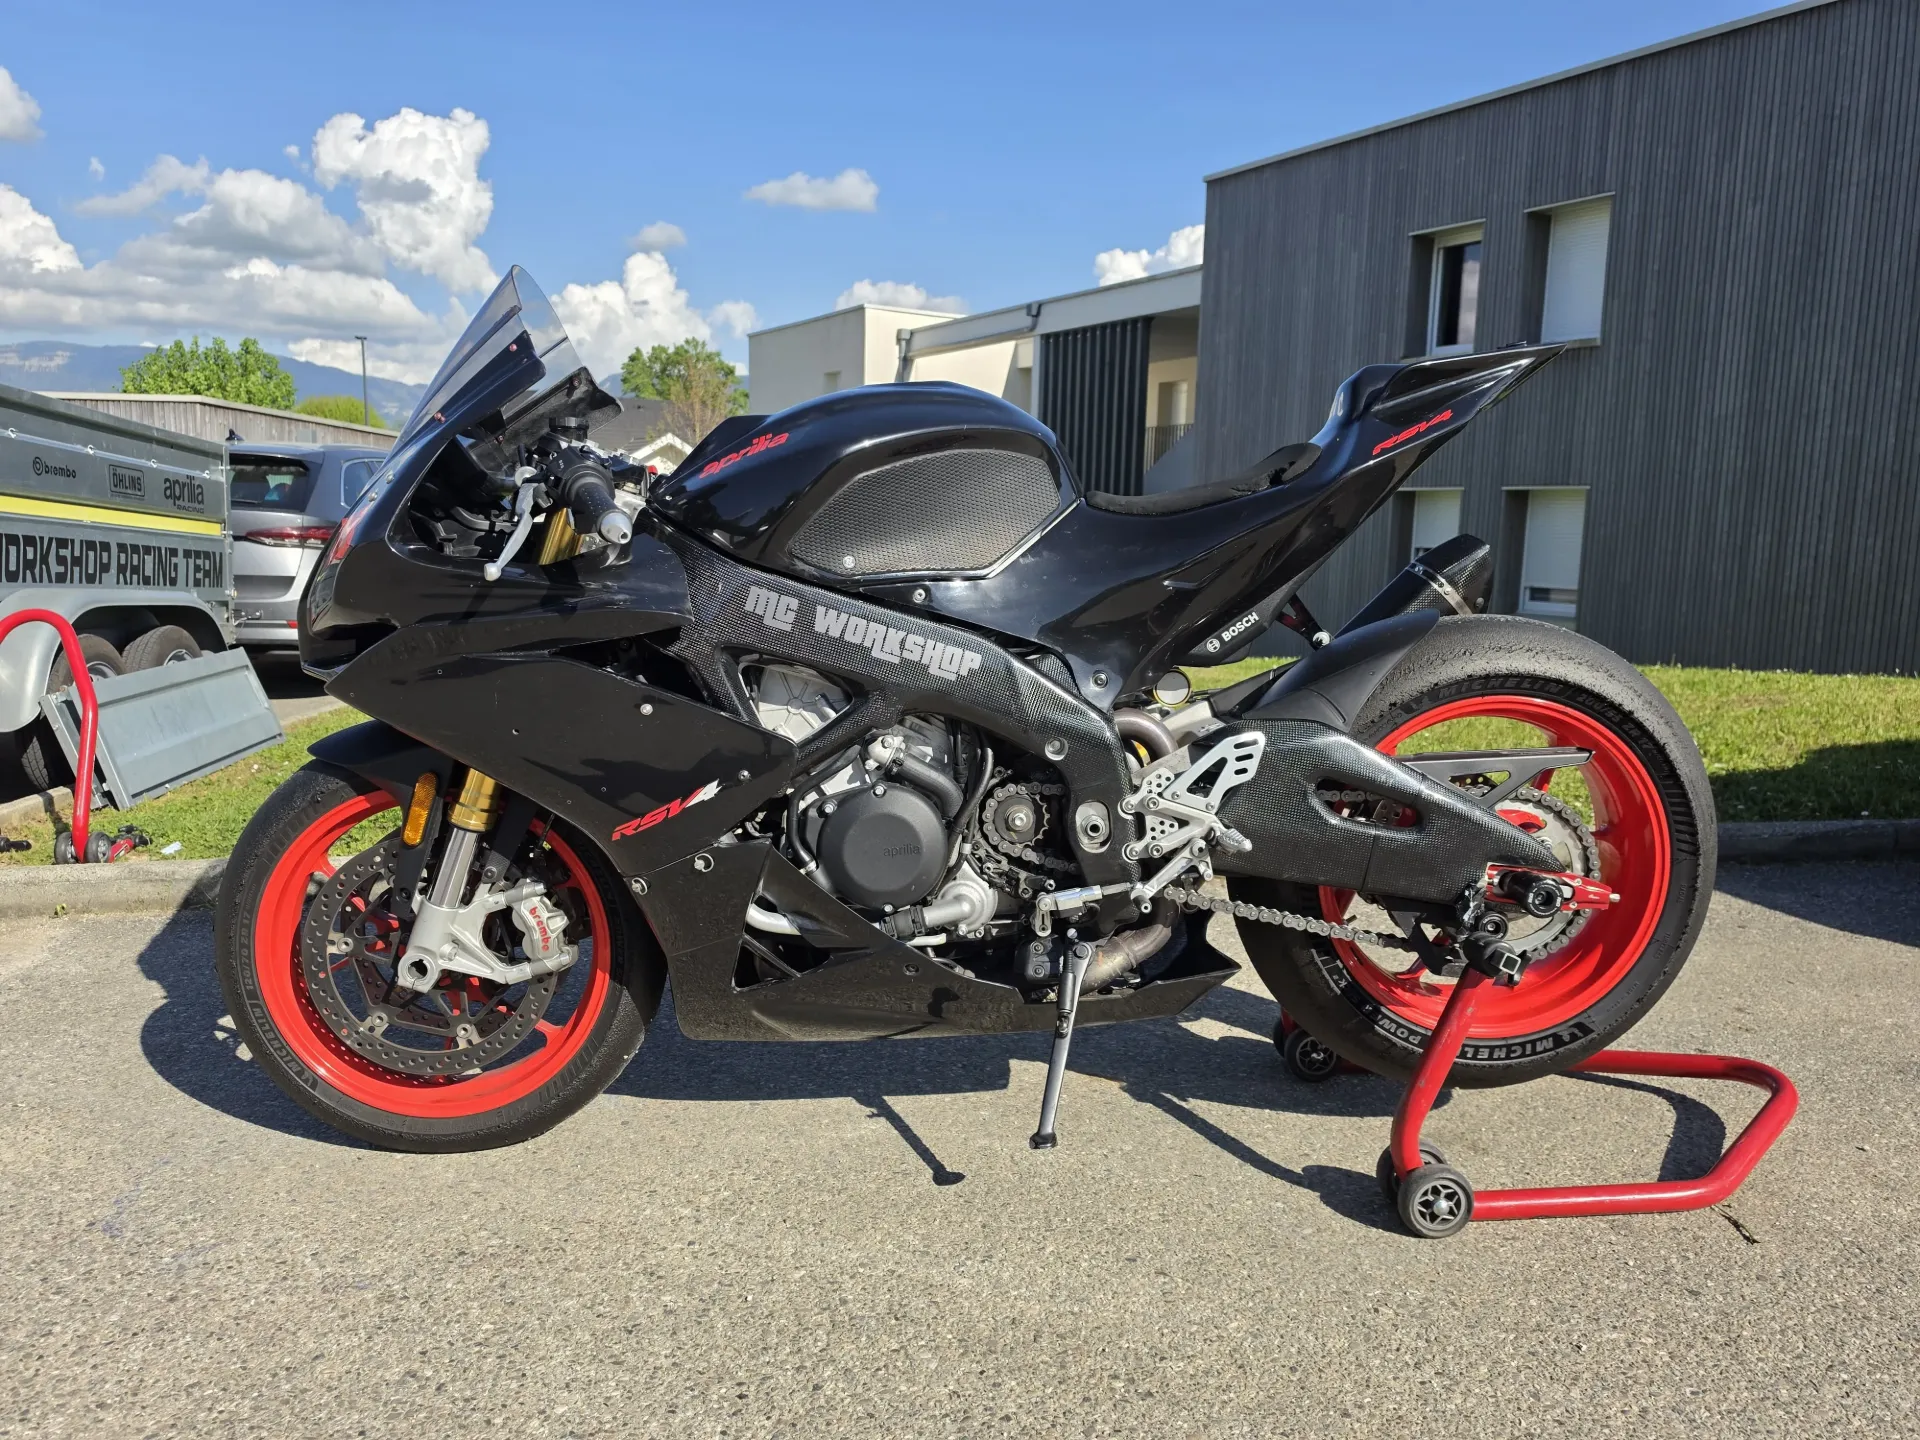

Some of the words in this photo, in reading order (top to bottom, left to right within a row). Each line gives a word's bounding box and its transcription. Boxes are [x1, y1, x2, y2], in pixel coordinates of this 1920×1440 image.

[44, 461, 76, 479] brembo
[700, 432, 789, 478] aprilia
[113, 468, 142, 492] ÖHLINS
[163, 475, 205, 506] aprilia
[176, 504, 205, 514] RACING
[0, 533, 111, 585] ORKSHOP
[116, 542, 178, 587] RACING
[183, 548, 223, 588] TEAM
[745, 586, 798, 632] MC
[814, 604, 982, 681] WORKSHOP
[1221, 612, 1259, 642] BOSCH
[612, 778, 723, 841] RSV4
[883, 843, 921, 858] aprilia
[529, 906, 552, 952] brembo
[252, 1007, 302, 1073] MICHELIN
[1463, 1036, 1555, 1060] MICHEL
